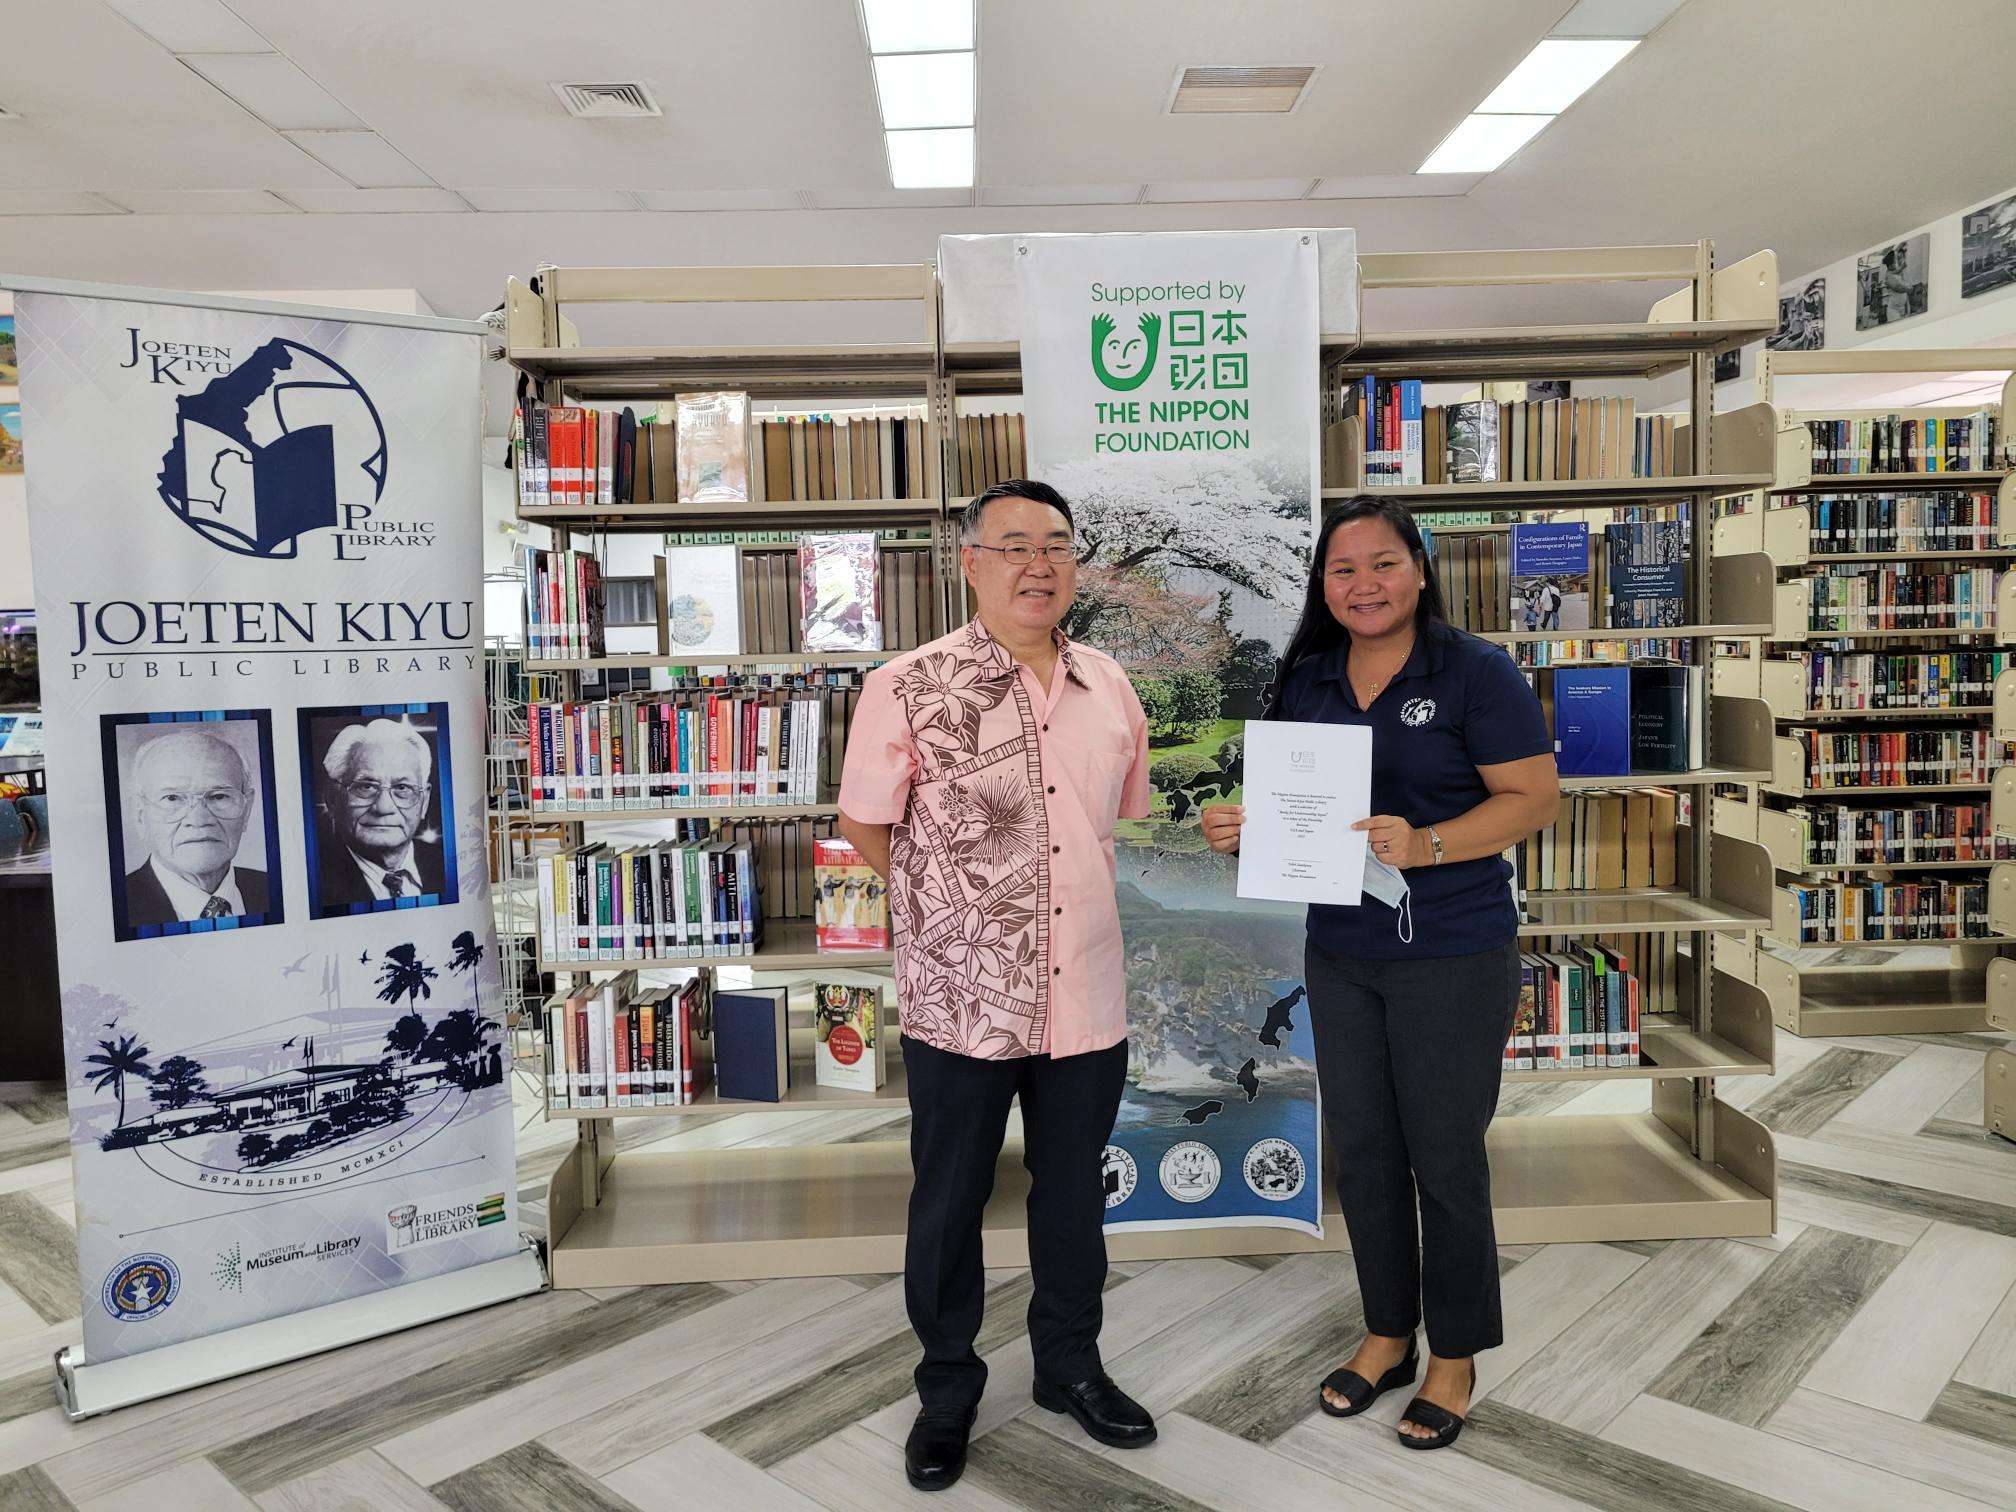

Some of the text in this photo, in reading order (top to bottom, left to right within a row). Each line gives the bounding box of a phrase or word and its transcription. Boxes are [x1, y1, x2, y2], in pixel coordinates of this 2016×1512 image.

[1091, 280, 1246, 306] Supported by
[120, 327, 232, 368] JOETEN
[147, 354, 232, 386] KIYU
[1095, 399, 1249, 424] THE NIPPON
[1095, 429, 1249, 453] FOUNDATION
[339, 503, 434, 532] PUBLIC
[330, 533, 437, 561] LIBRARY
[1565, 534, 1584, 542] Family
[1567, 542, 1583, 550] Japan
[1640, 565, 1671, 573] Historical
[70, 601, 473, 656] JOETEN KIYU
[72, 654, 476, 680] PUBLIC LIBRARY
[653, 728, 661, 747] erotic
[710, 716, 718, 774] GOVERNING JAP
[544, 752, 552, 773] Politics
[727, 872, 737, 896] MITI
[655, 1021, 664, 1071] WHY ADJUDIC
[665, 1023, 673, 1062] BUSHIDO
[199, 1141, 404, 1188] ESTABLISHED MCMXCI
[415, 1203, 474, 1227] FRIENDS
[415, 1214, 477, 1242] LIBRARY
[246, 1249, 304, 1272] Museum
[316, 1236, 361, 1255] Library
[259, 1243, 296, 1259] INSTITUTE
[317, 1247, 354, 1262] SERVICES
